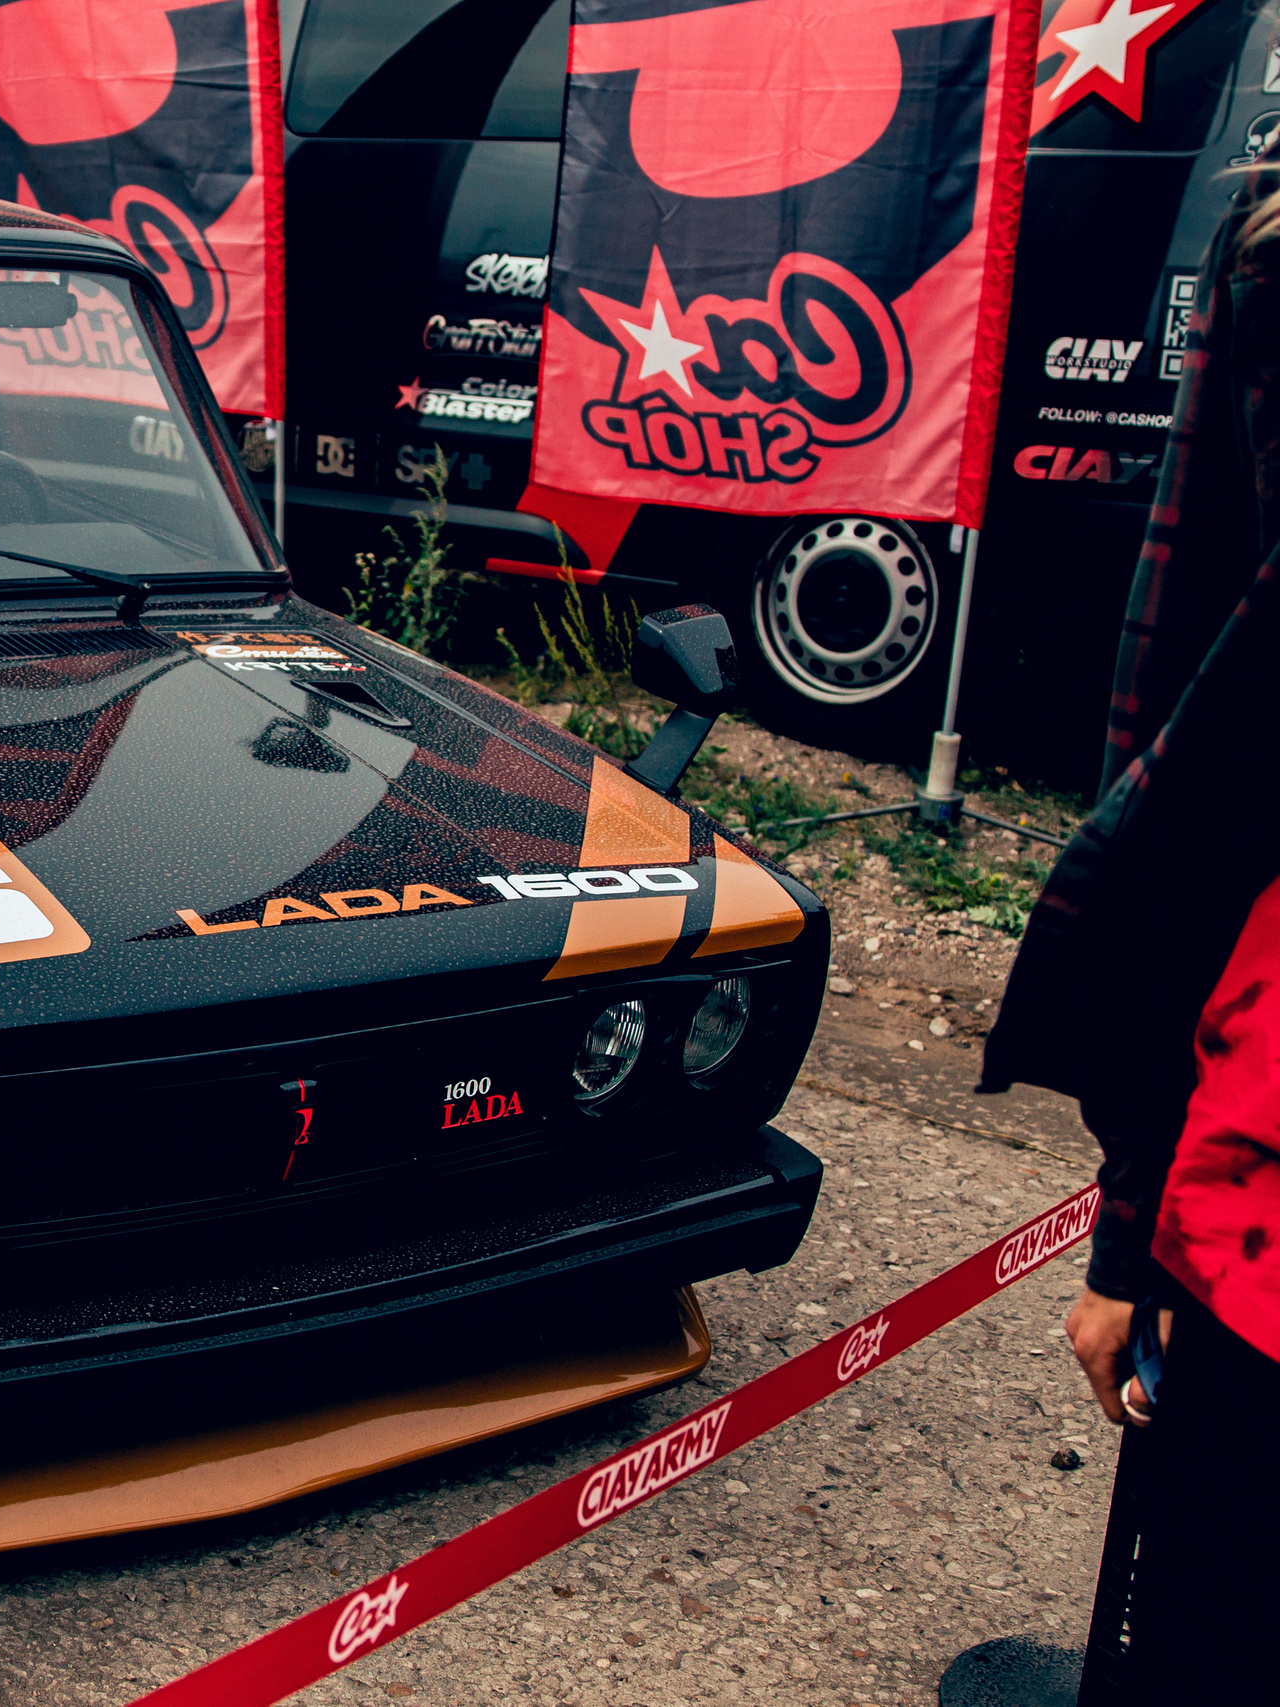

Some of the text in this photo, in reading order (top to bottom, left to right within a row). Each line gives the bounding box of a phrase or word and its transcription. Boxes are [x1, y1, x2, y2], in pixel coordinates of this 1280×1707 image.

[176, 866, 699, 935] LADA 1600
[443, 1076, 492, 1101] 1600
[441, 1091, 524, 1130] LADA
